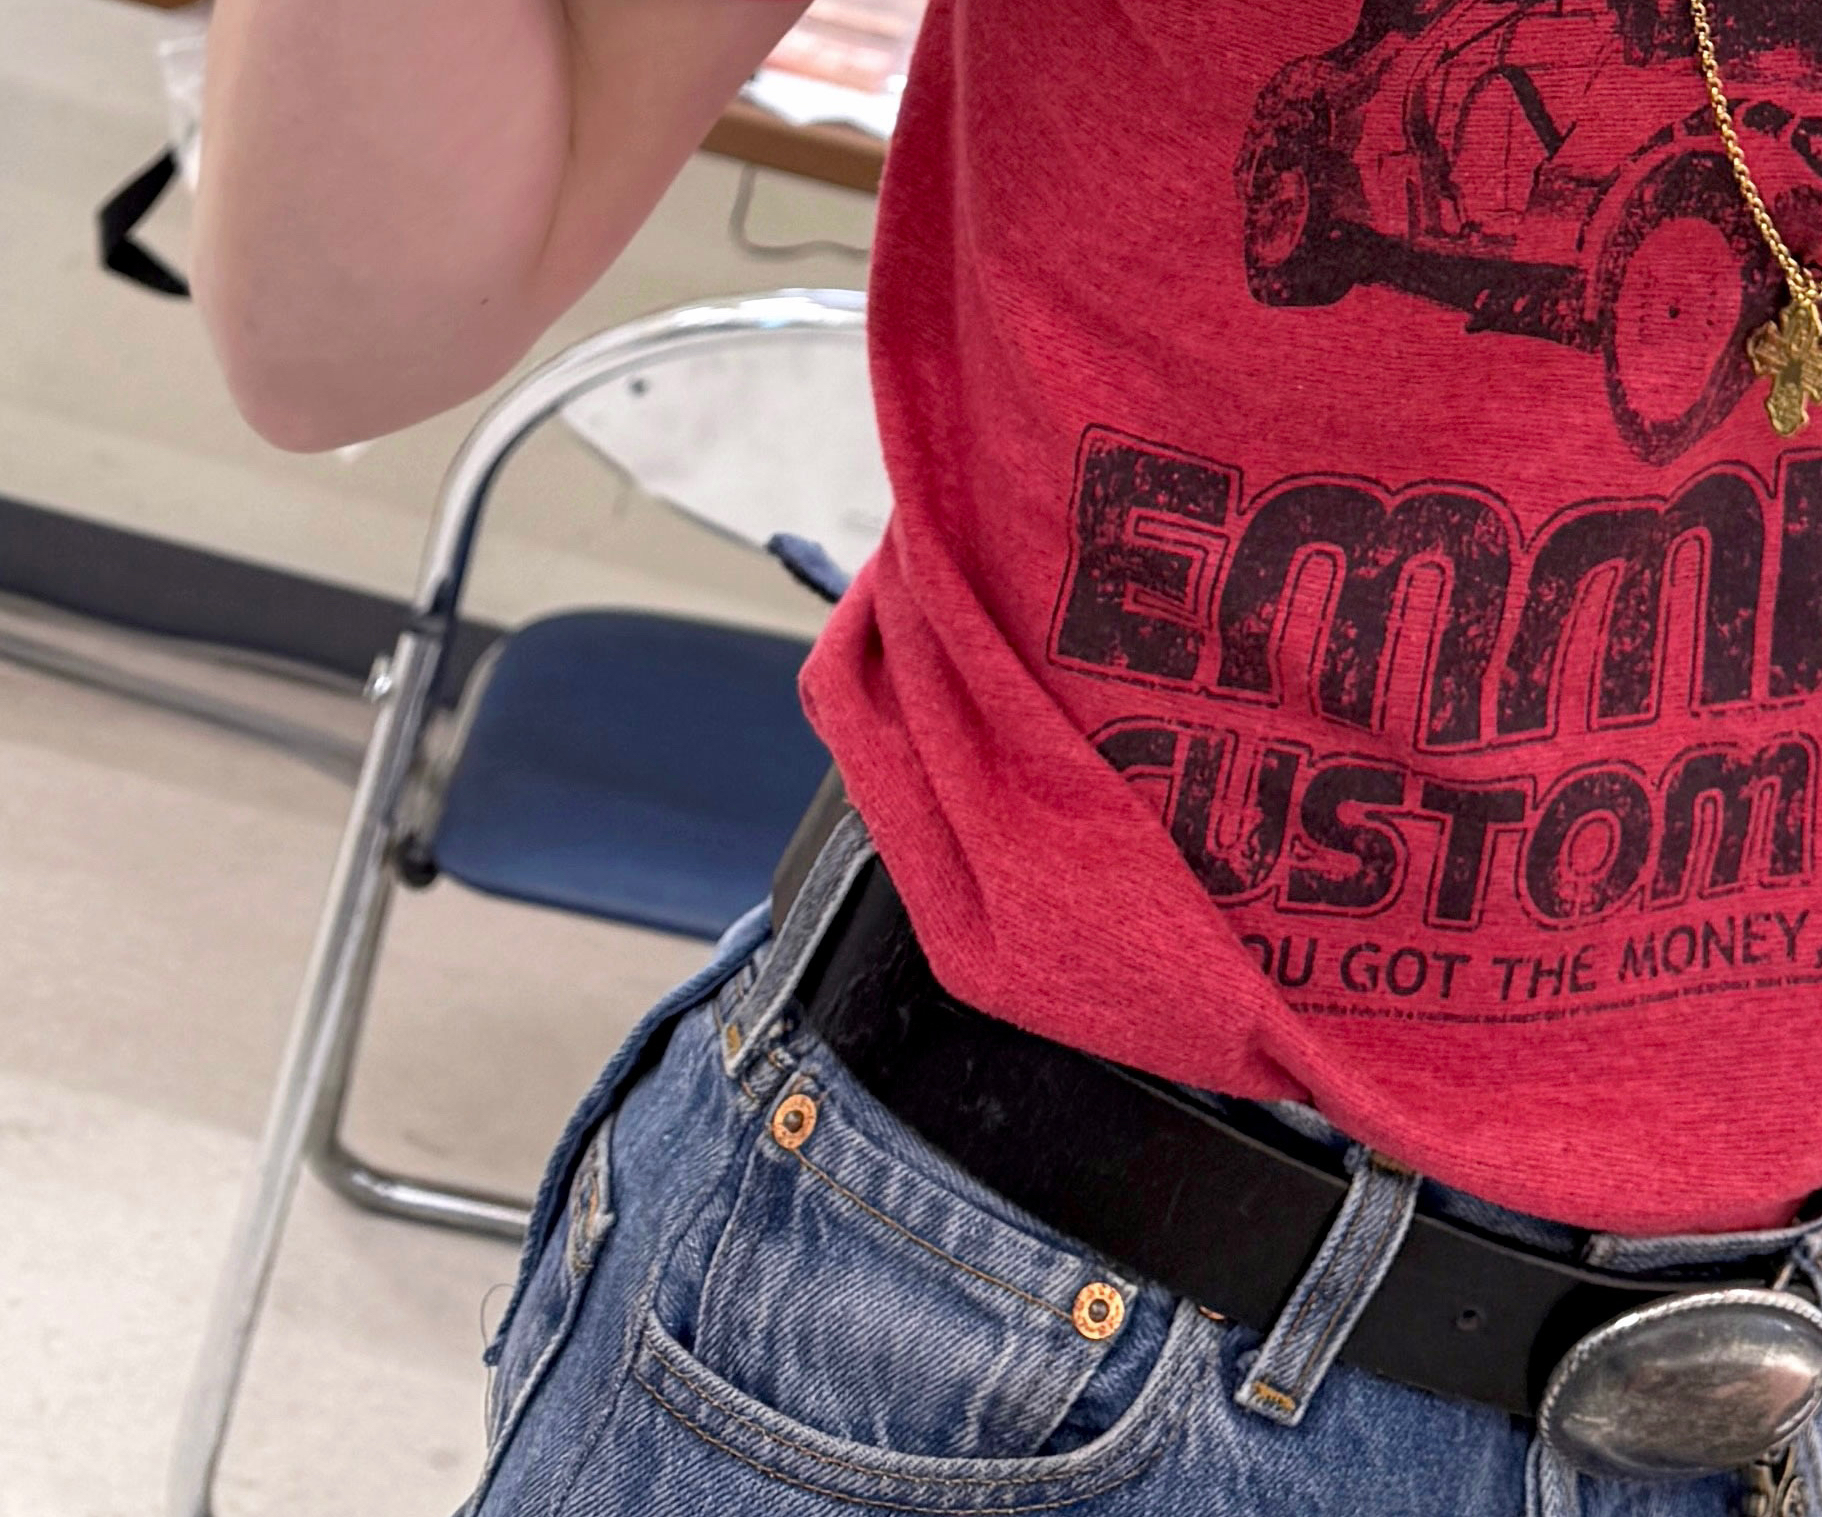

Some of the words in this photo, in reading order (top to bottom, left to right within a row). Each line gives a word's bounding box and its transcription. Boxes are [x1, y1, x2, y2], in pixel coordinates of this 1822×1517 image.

[1241, 934, 1318, 988] OU
[1340, 942, 1473, 999] GOT
[1491, 944, 1597, 1000] THE
